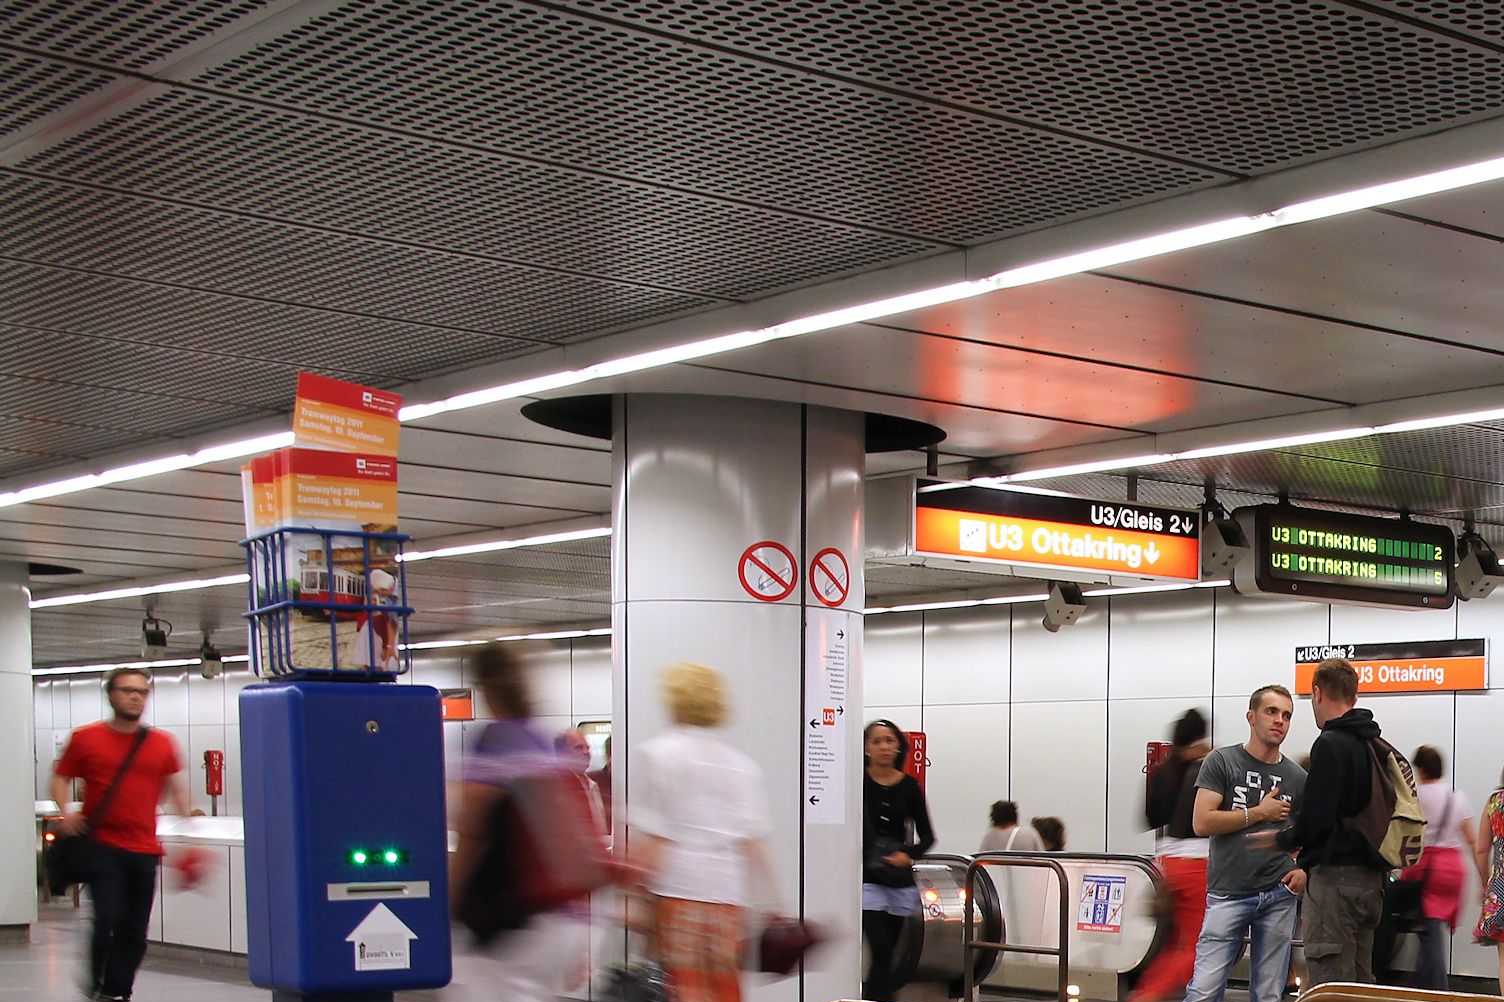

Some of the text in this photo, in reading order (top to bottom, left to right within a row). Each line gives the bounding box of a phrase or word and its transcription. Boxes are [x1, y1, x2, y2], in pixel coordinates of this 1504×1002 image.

[298, 483, 360, 497] Tramwaytag 2011
[345, 498, 384, 509] September
[1090, 504, 1181, 534] U3/Gleis 2
[989, 523, 1143, 568] U3 Ottakring
[1271, 526, 1443, 561] U3 OTTAKRING 2
[1271, 553, 1443, 586] U3 OTTAKRING 5
[1305, 645, 1355, 660] U3/Gleis 2
[1355, 664, 1444, 685] U3 Ottakring
[823, 711, 835, 722] U3
[914, 739, 923, 774] NOT
